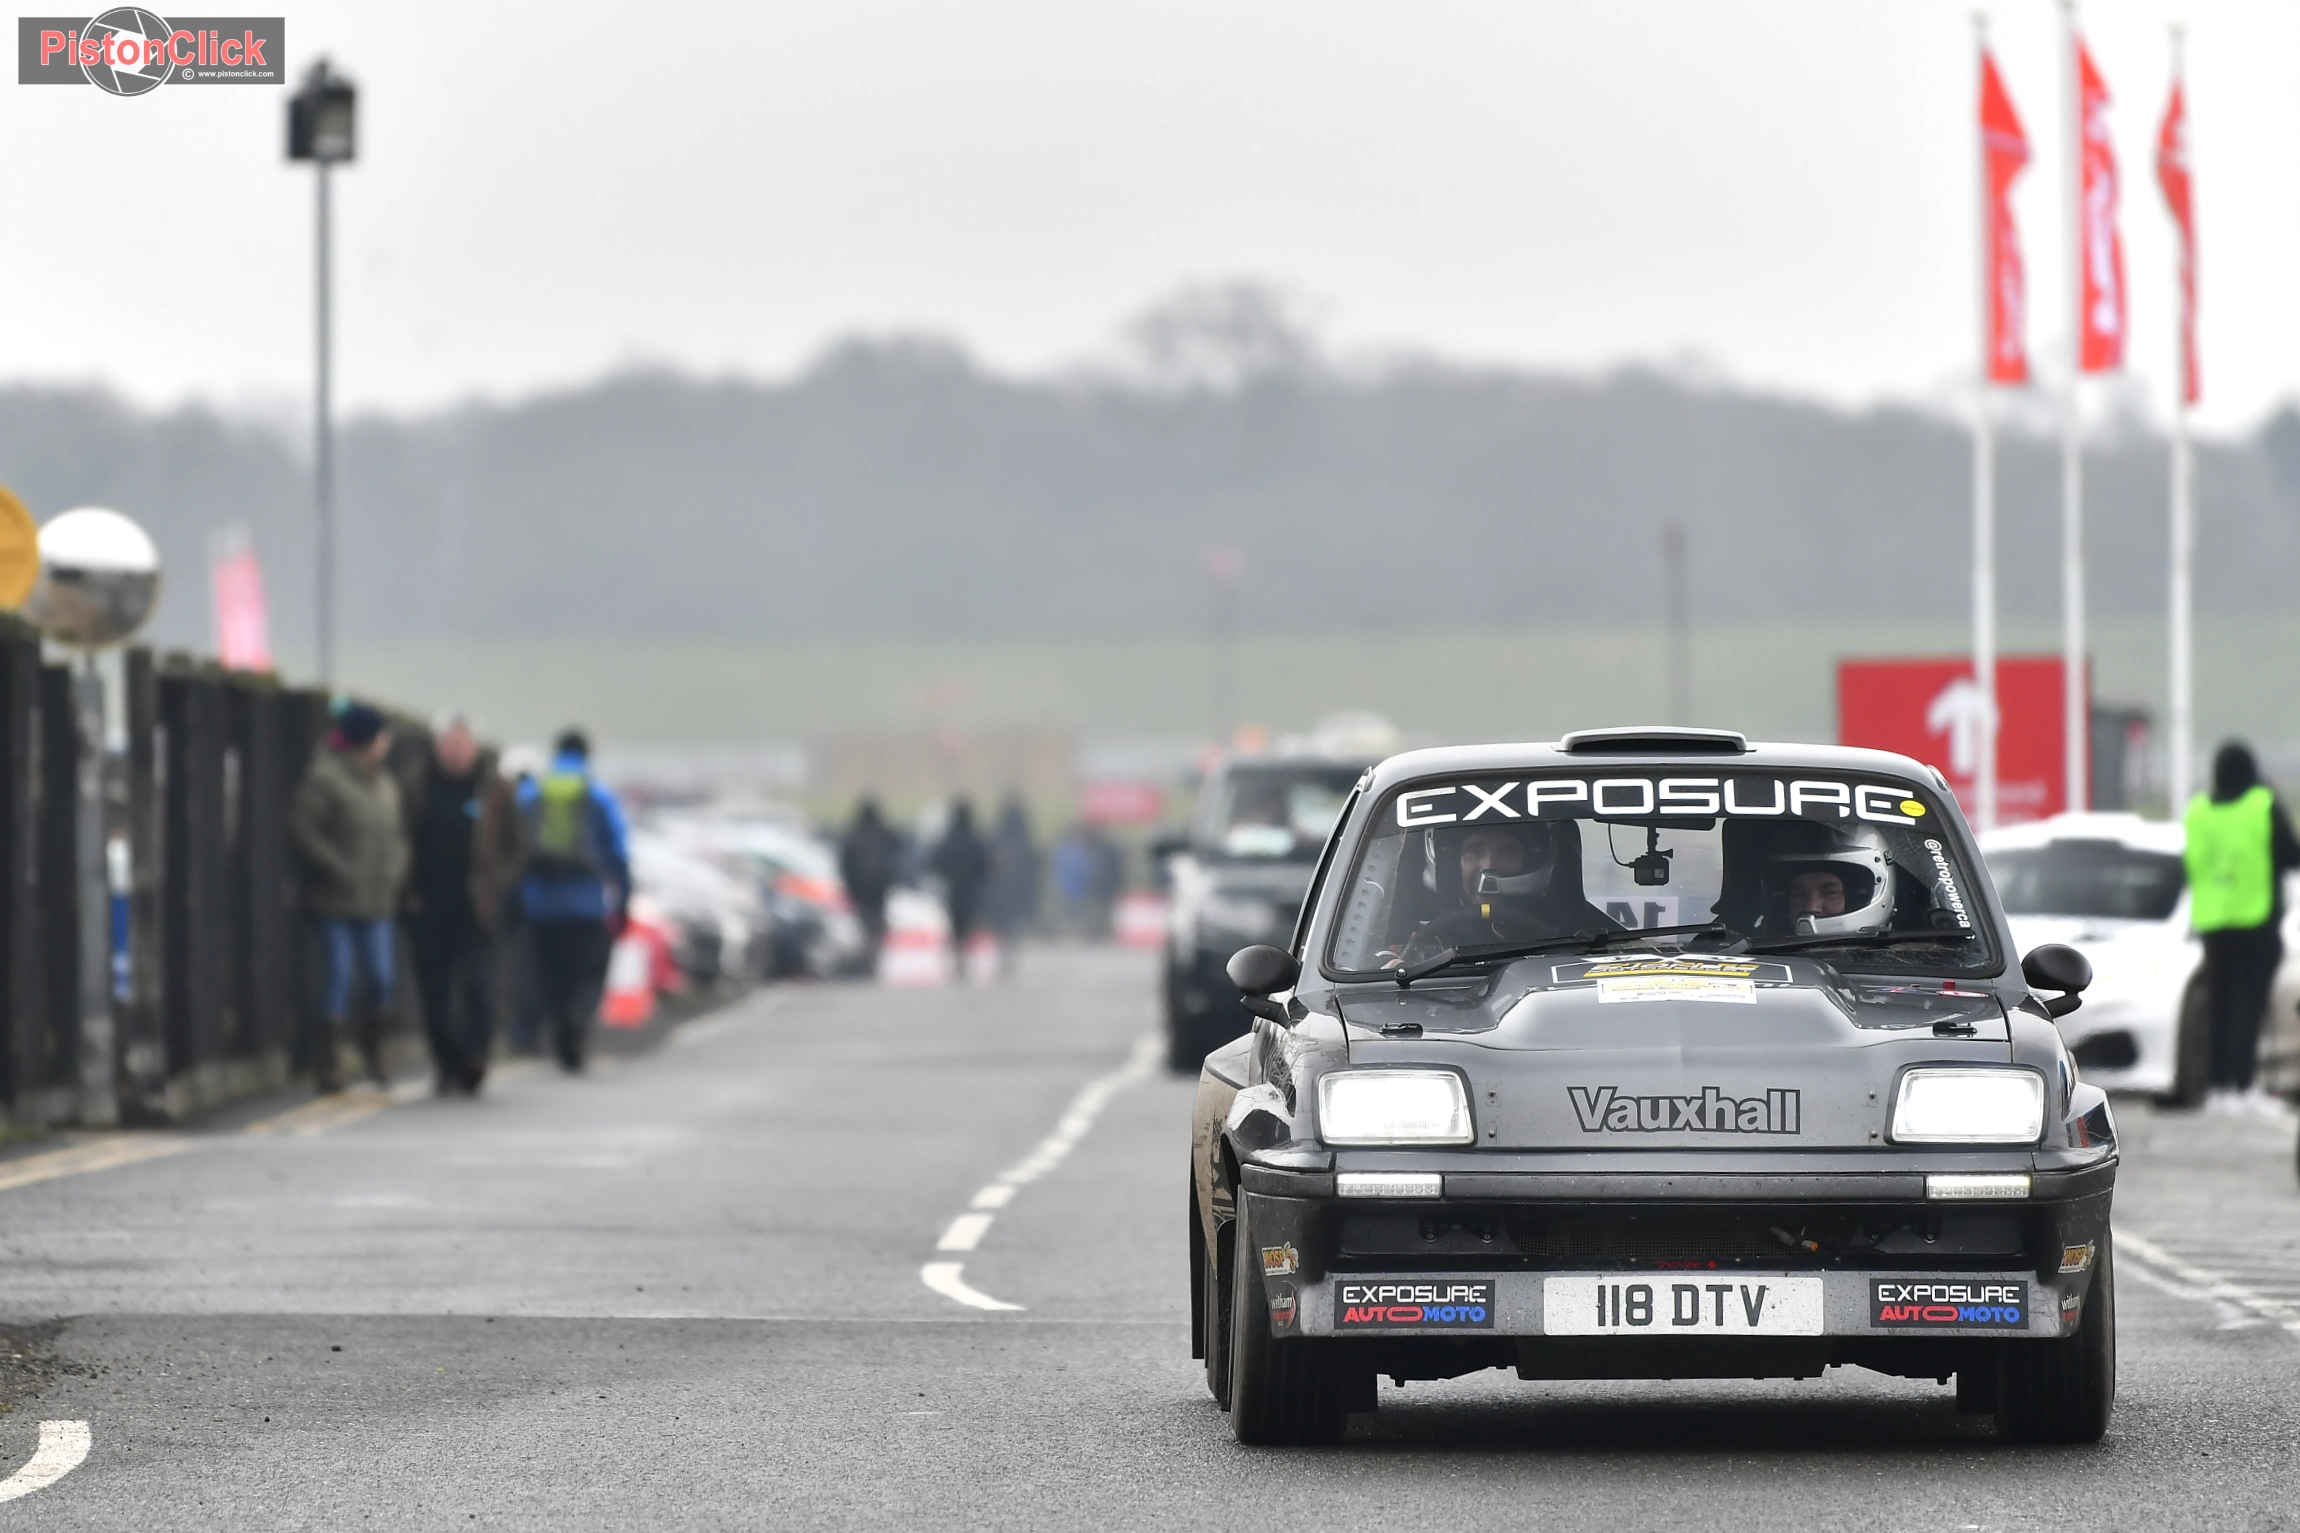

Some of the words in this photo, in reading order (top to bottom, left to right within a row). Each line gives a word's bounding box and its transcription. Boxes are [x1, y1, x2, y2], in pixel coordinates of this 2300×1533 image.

[1396, 777, 1916, 828] EXPOSURE
[1566, 1085, 1801, 1135] Vauxhall
[1342, 1285, 1487, 1304] EXPOSURE
[1597, 1284, 1654, 1327] 118
[1671, 1283, 1767, 1327] DTV
[1878, 1284, 2021, 1303] EXPOSURE
